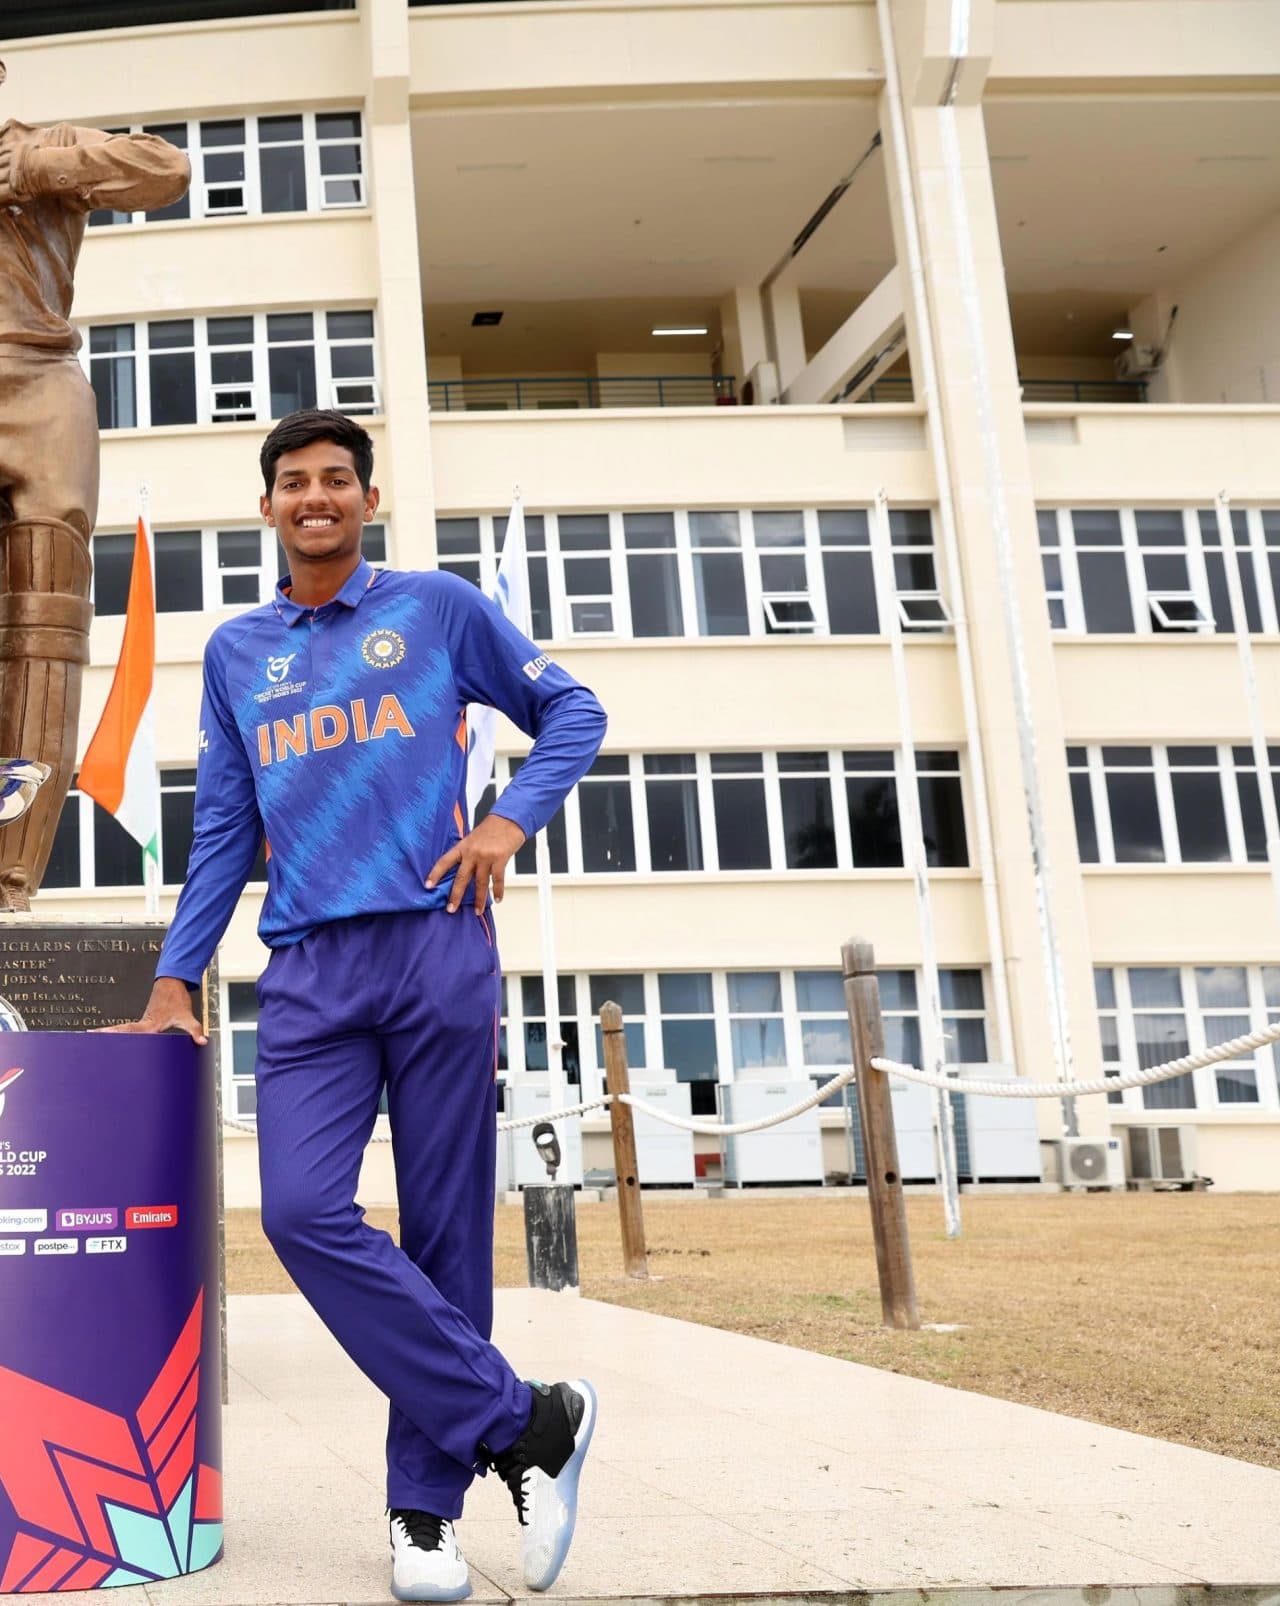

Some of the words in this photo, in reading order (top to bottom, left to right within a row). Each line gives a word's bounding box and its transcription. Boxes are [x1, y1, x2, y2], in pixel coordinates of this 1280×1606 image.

[257, 694, 416, 767] INDIA
[58, 974, 116, 984] ANTIGUA
[19, 1151, 47, 1163] CUP
[6, 1164, 37, 1176] 2022
[76, 1212, 113, 1226] BYJU'S
[132, 1211, 172, 1224] Emirates
[37, 1242, 69, 1252] postpe
[101, 1240, 123, 1251] FTX
